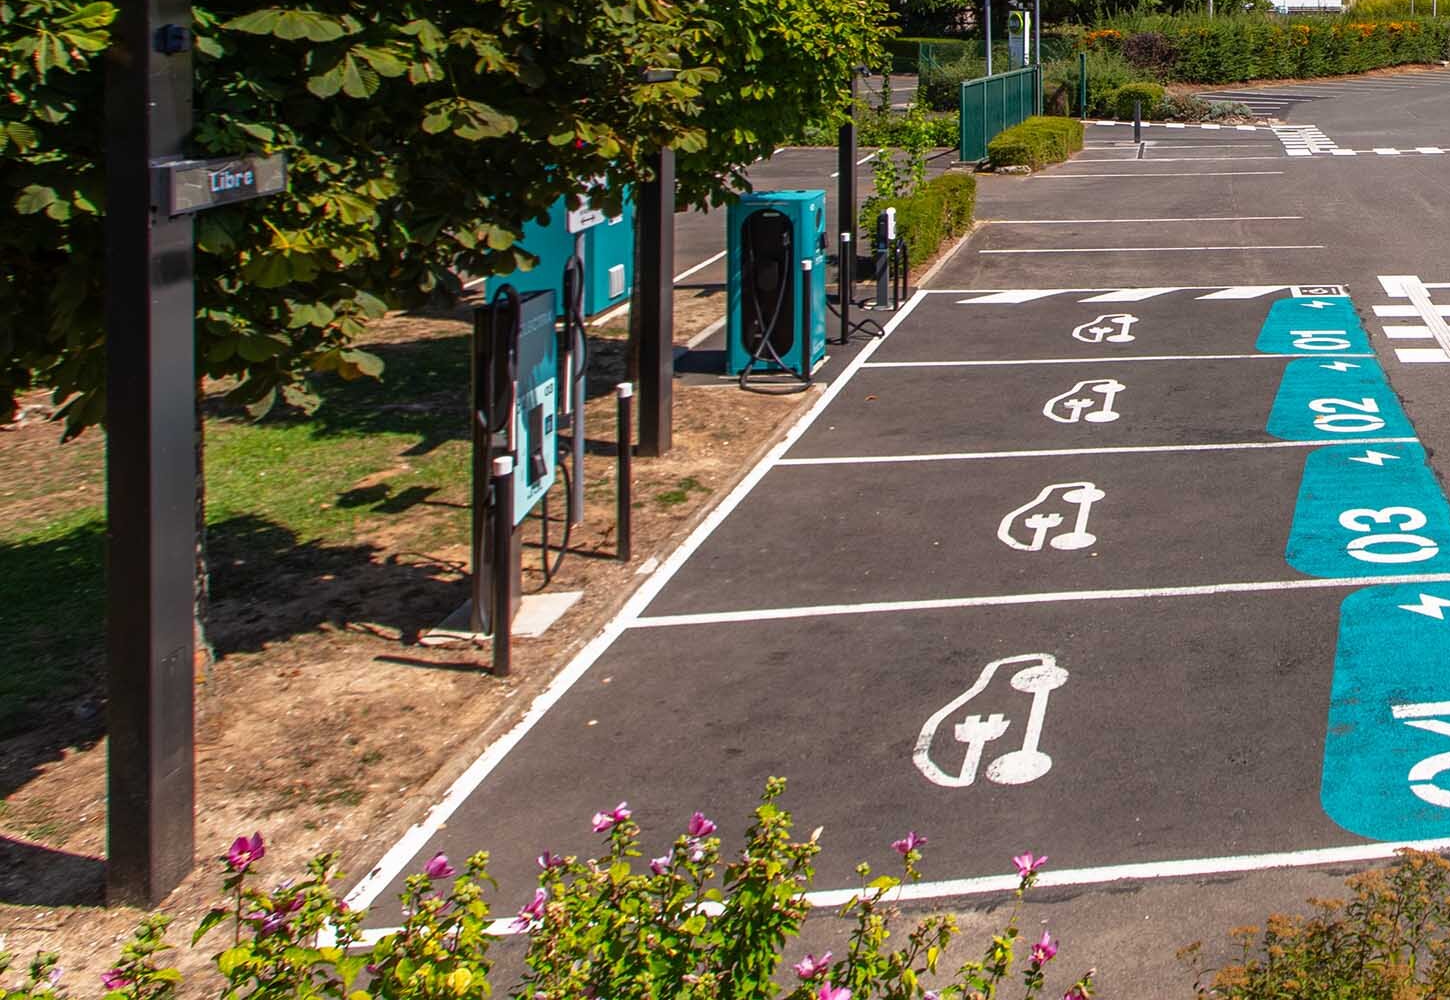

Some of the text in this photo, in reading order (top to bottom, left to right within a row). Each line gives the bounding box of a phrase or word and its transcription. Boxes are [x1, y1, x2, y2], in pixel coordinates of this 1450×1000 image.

[208, 170, 254, 192] Libre
[1290, 330, 1351, 350] 01
[1308, 398, 1385, 432] 02
[1339, 506, 1439, 563] 03
